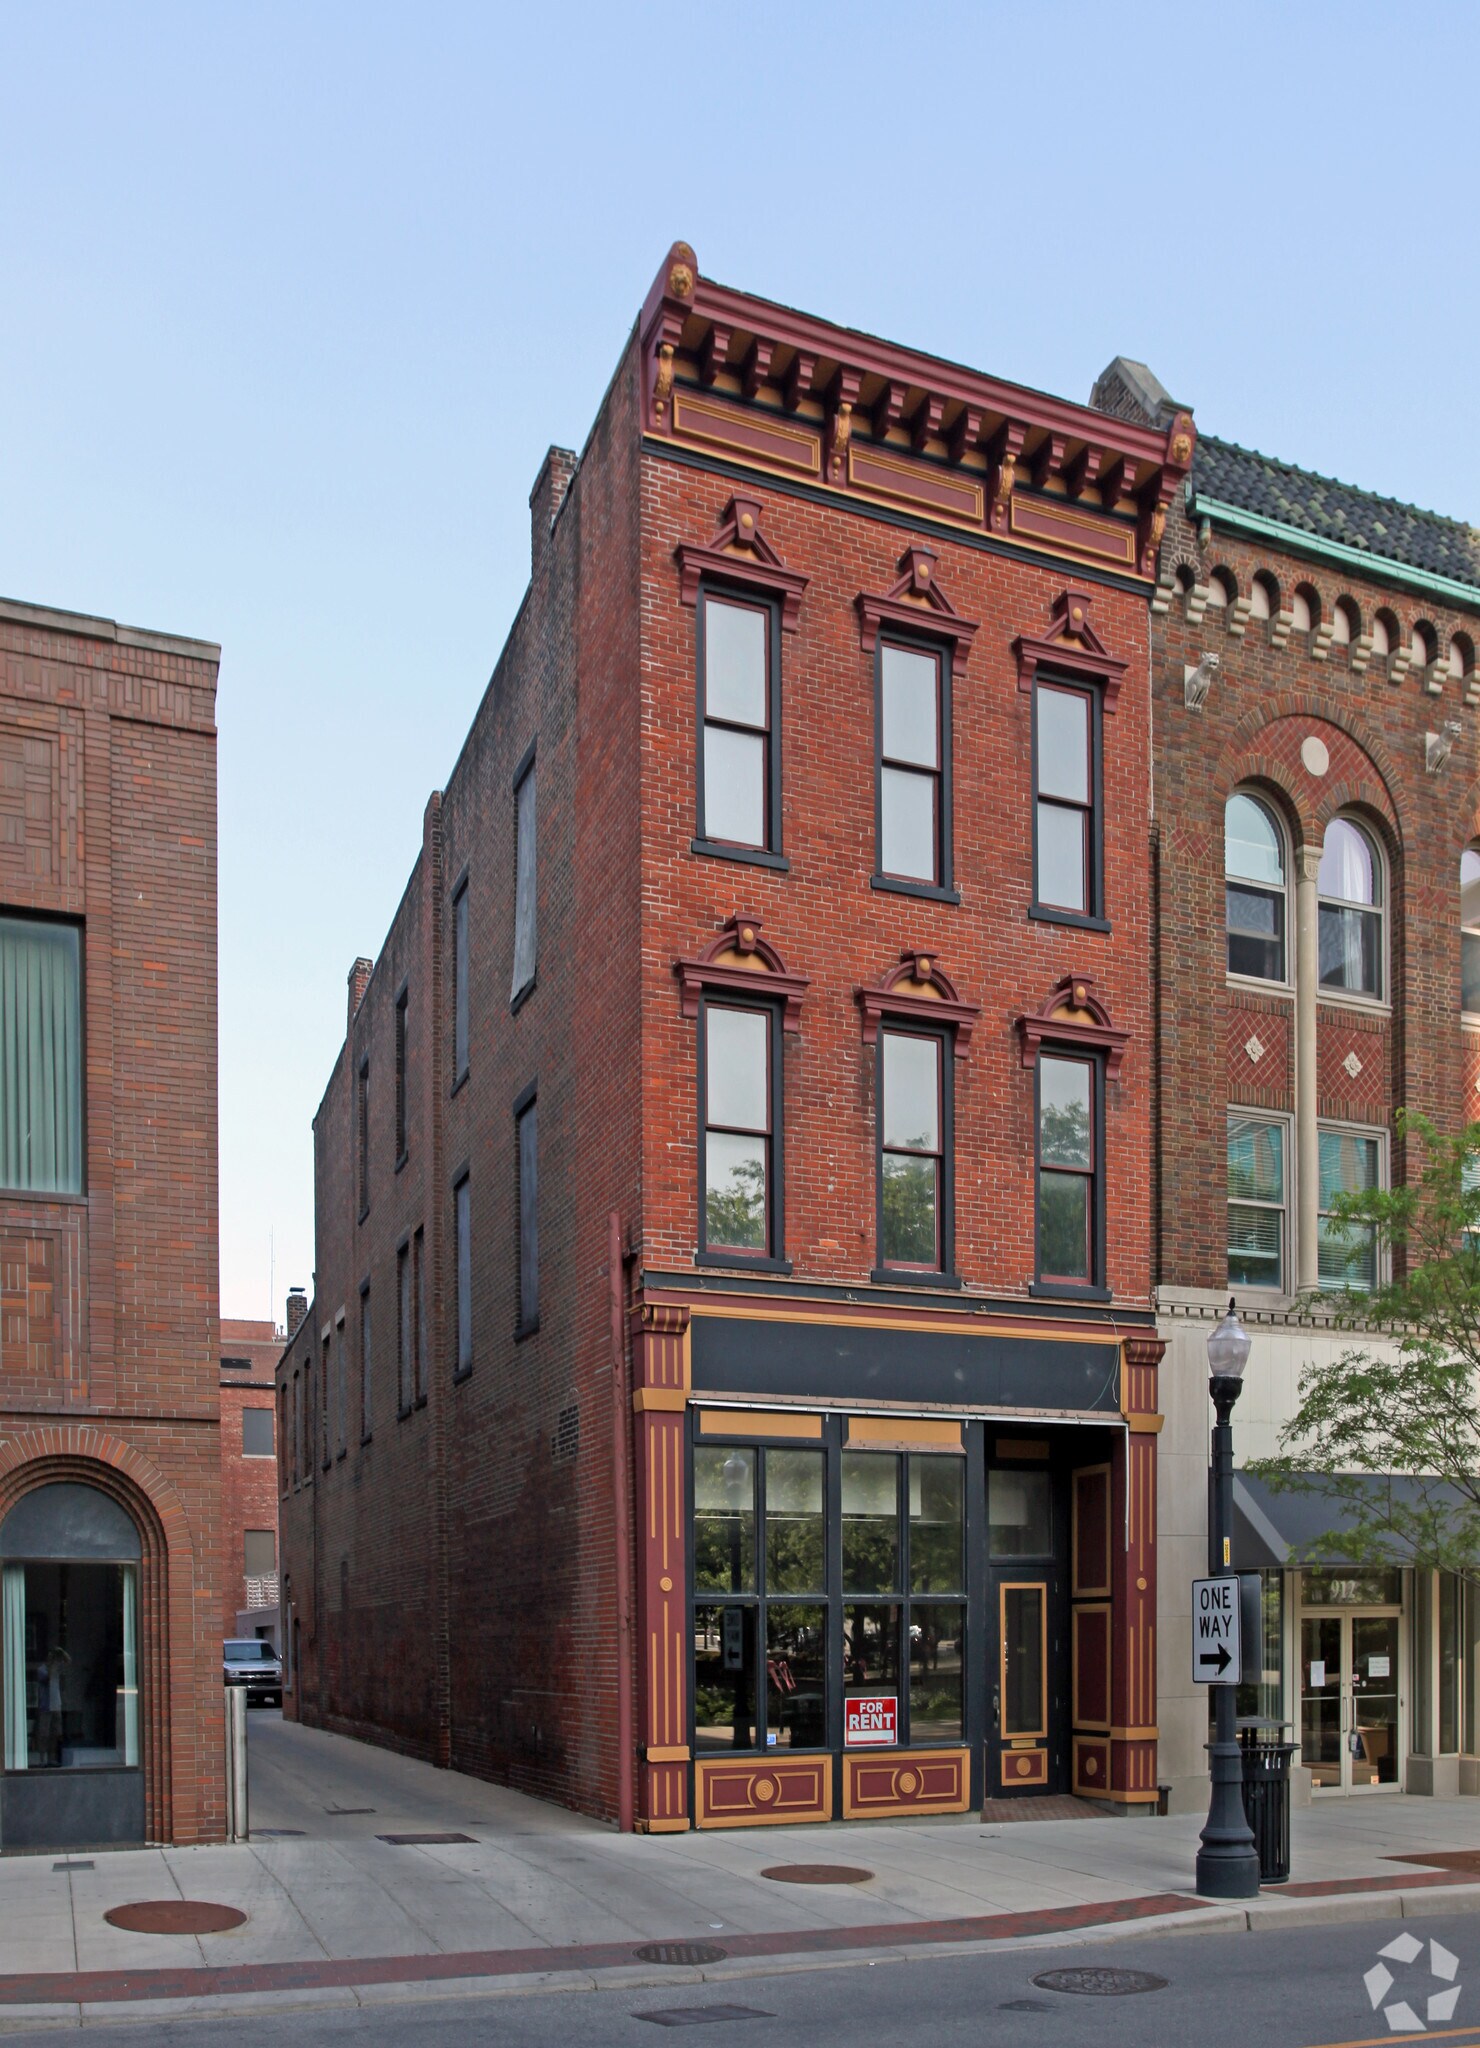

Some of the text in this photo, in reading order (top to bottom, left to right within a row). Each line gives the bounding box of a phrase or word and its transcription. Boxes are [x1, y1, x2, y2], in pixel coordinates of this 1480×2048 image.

[1330, 1579, 1356, 1598] 912
[1200, 1586, 1231, 1611] ONE
[1199, 1614, 1232, 1638] WAY
[859, 1702, 883, 1713] FOR
[849, 1713, 894, 1730] RENT
